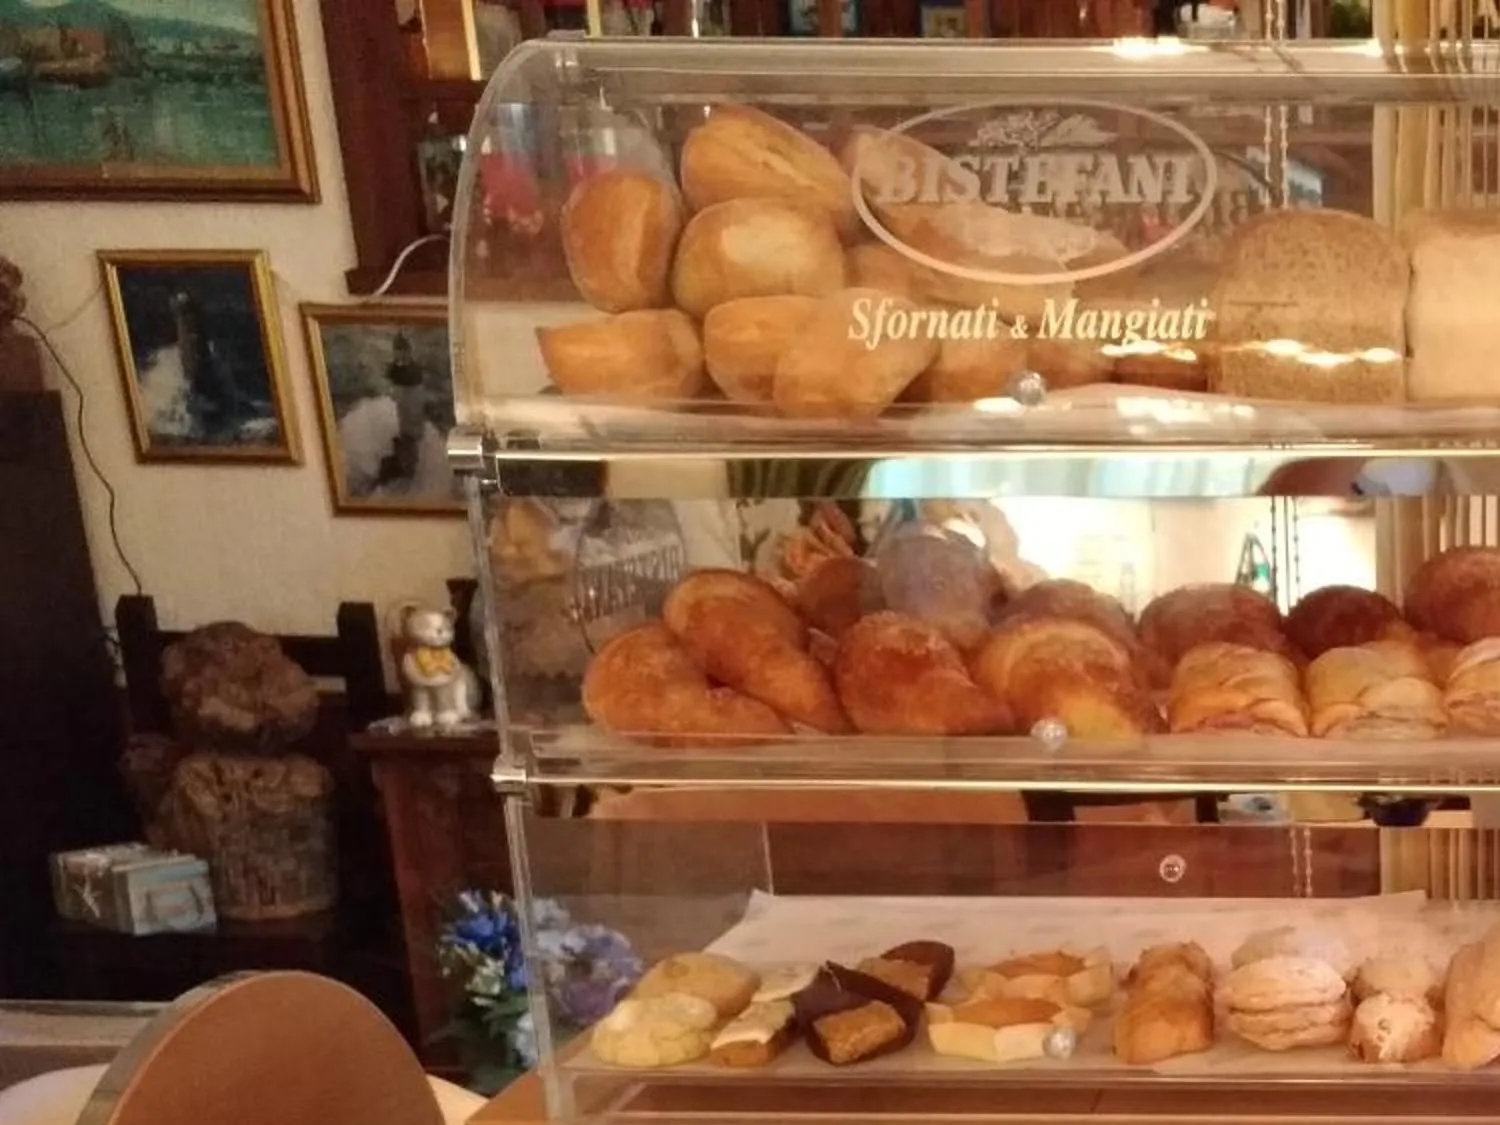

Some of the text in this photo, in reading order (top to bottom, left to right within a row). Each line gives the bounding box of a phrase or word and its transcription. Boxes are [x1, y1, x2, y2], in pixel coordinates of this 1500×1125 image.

[875, 153, 1194, 203] BISTEFANI
[847, 297, 1212, 350] Sfornati & Mangiati
